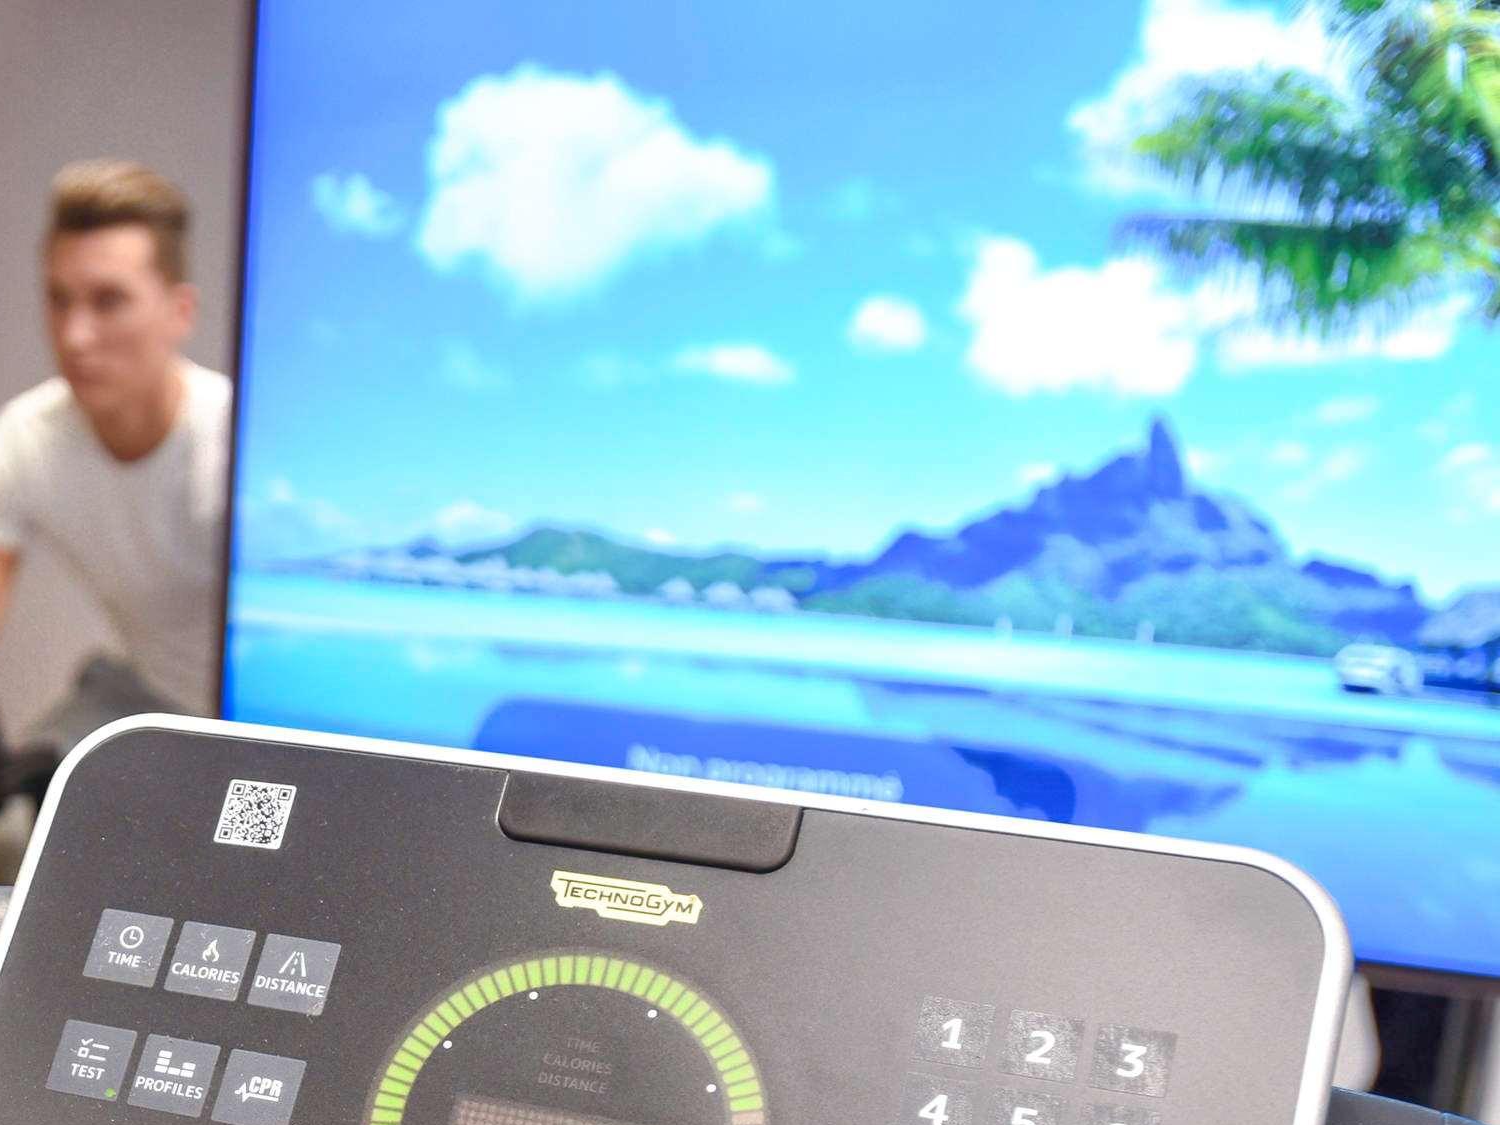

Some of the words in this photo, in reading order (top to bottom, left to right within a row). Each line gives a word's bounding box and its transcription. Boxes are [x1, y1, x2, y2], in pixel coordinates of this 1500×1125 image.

[107, 951, 143, 969] TIME
[171, 962, 241, 986] CALORIES
[254, 974, 326, 999] DISTANCE
[939, 1016, 964, 1051] 1
[567, 1038, 600, 1053] TIME
[1023, 1029, 1057, 1065] 2
[543, 1052, 612, 1074] CALORIES
[1115, 1041, 1148, 1079] 3
[69, 1062, 105, 1082] TEST
[538, 1072, 608, 1094] DISTANCE
[134, 1075, 204, 1100] PROFILES
[249, 1076, 284, 1099] CPR
